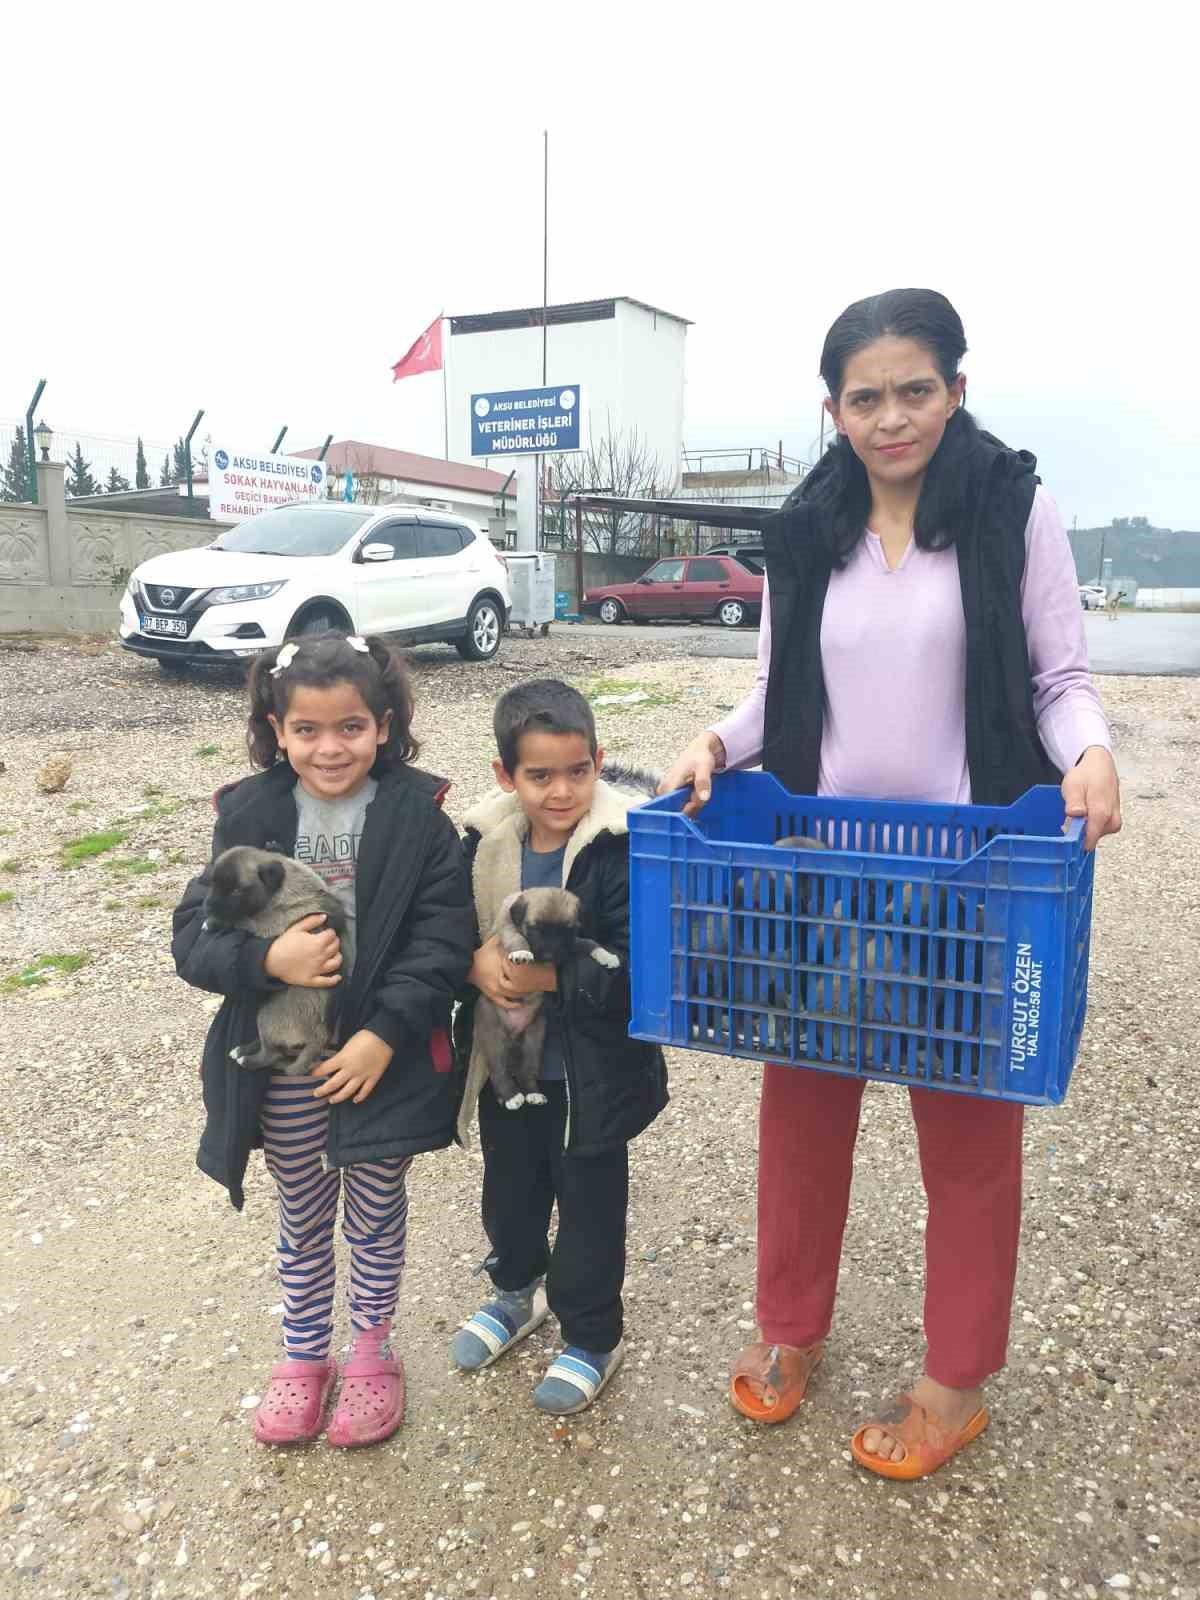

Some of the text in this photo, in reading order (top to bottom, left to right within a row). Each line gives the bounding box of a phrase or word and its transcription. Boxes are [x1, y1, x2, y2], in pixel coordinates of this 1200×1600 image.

[493, 396, 556, 411] AKSU BELEDİYESİ
[478, 412, 572, 433] VETERİNER İŞLERİ
[492, 432, 557, 450] MÜDÜRLÜĞÜ
[233, 456, 308, 479] AKSU BELEDİYESİ
[224, 473, 317, 494] SOKAK HAYVANLARI
[1010, 943, 1032, 1072] TURGUT ÖZEN
[1026, 960, 1043, 1057] HAL NO:58 ANT.
